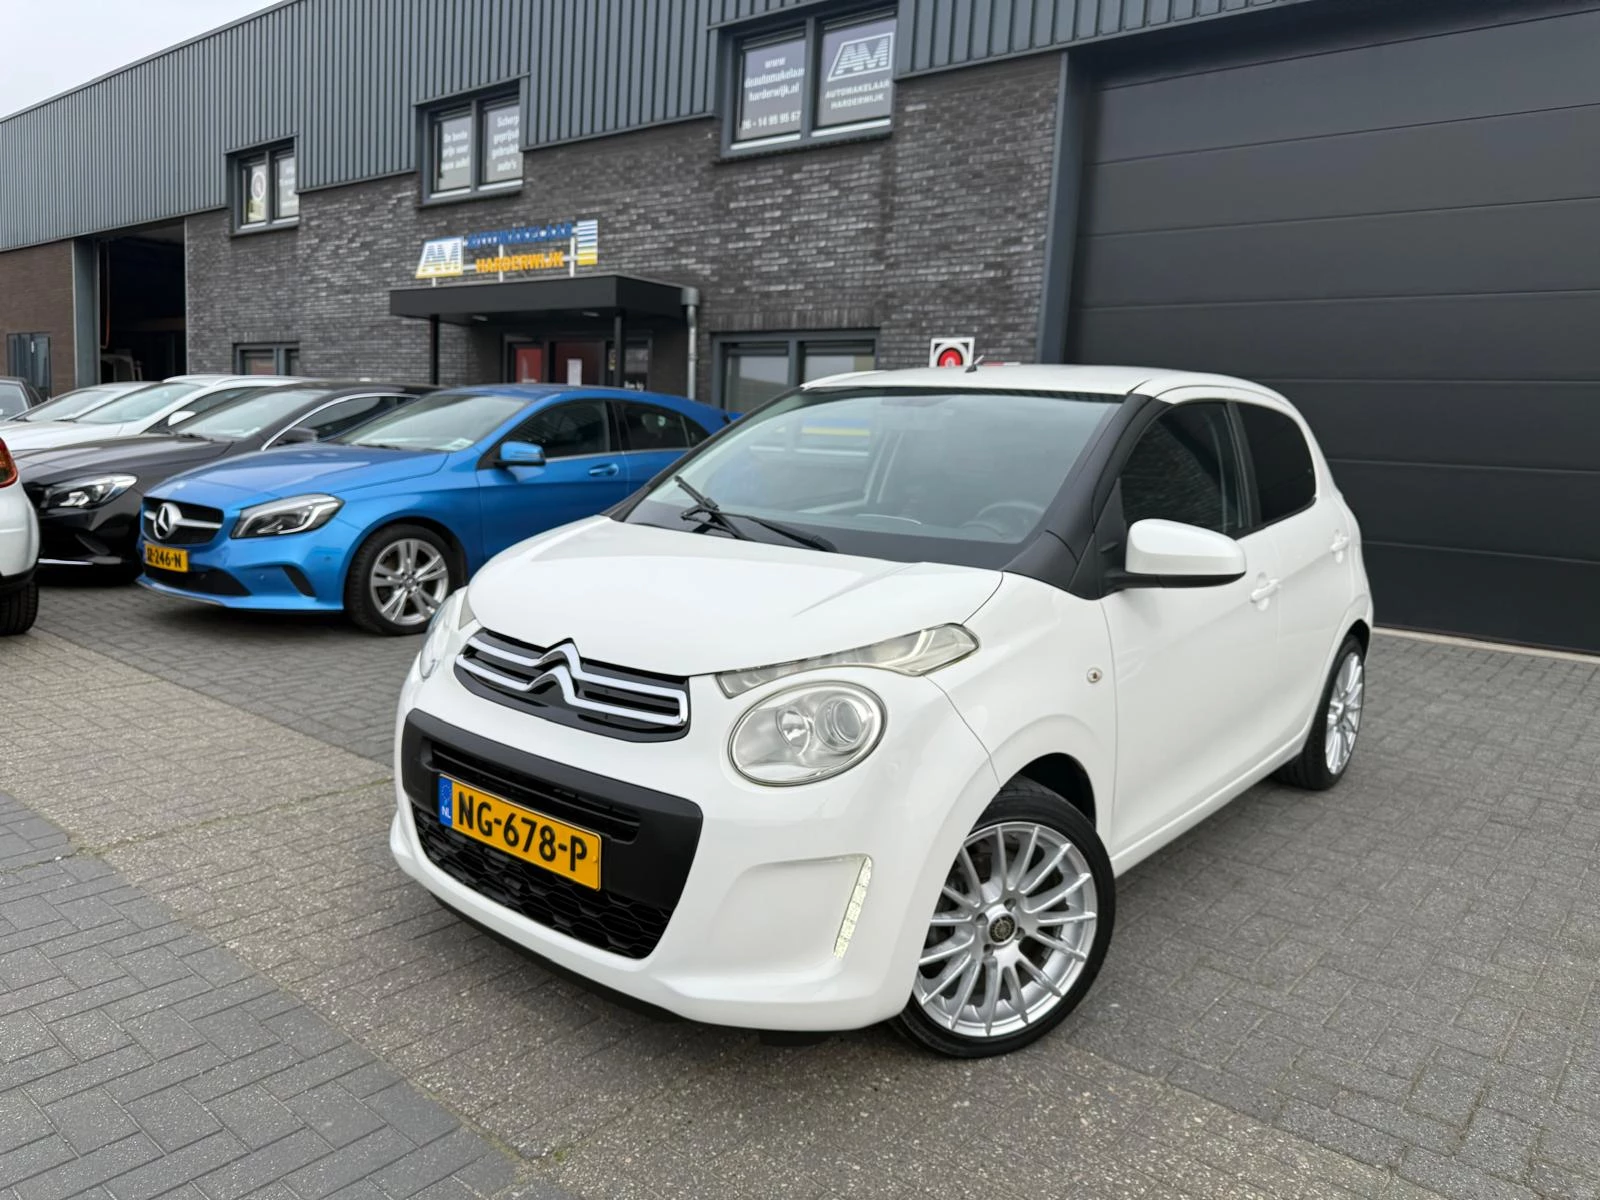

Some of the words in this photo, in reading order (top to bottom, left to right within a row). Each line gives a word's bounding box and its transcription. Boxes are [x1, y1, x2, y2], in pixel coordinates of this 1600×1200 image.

[833, 37, 890, 76] AM
[825, 79, 890, 99] AUTOMAKELAAR
[830, 93, 884, 110] HARDERWIJK
[475, 251, 564, 273] HARDERWIJK
[441, 805, 452, 819] NL
[458, 791, 588, 872] NG-678-P
